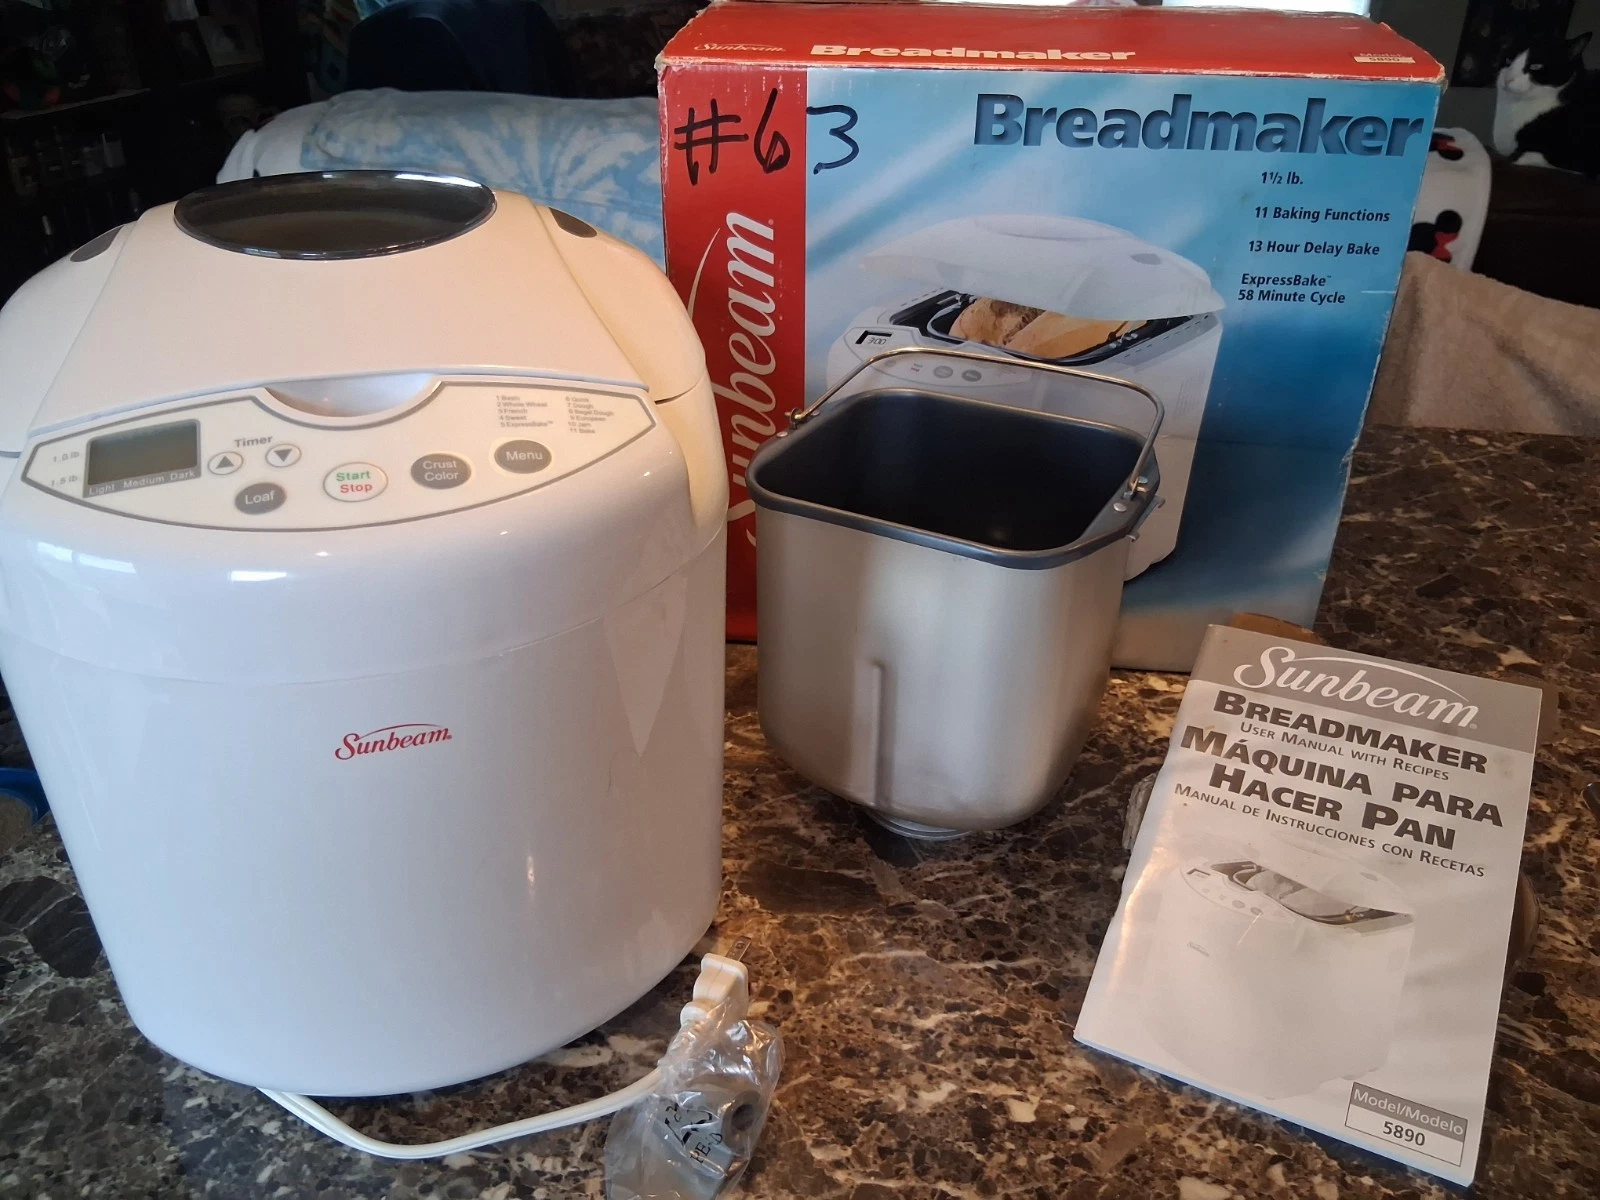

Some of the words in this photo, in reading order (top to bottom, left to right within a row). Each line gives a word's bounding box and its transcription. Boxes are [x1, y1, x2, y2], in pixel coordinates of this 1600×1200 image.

[810, 44, 1136, 60] Breadmaker
[973, 93, 1424, 157] Breadmaker
[1286, 171, 1304, 185] lb.
[1254, 206, 1268, 219] 11
[1273, 206, 1321, 223] Baking
[1324, 208, 1391, 222] Functions
[1248, 240, 1263, 252] 13
[1266, 240, 1301, 253] Hour
[1303, 241, 1343, 257] Delay
[1346, 242, 1380, 255] Bake
[1238, 289, 1254, 301] 58
[1258, 289, 1306, 303] Minute
[1310, 291, 1346, 305] Cycle
[234, 435, 274, 448] Timer
[506, 451, 543, 461] Menu
[422, 460, 457, 471] Crust
[88, 483, 116, 496] Light
[123, 474, 165, 489] Medium
[170, 470, 195, 482] Dark
[336, 470, 371, 482] Start
[424, 471, 459, 482] Color
[340, 483, 373, 494] Stop
[244, 489, 276, 505] Loaf
[1233, 646, 1480, 729] Sunbeam
[335, 723, 453, 760] Sunbeam
[1392, 782, 1504, 827] PARA
[1354, 1089, 1464, 1135] Model/Modelo
[1383, 1121, 1426, 1146] 5890
